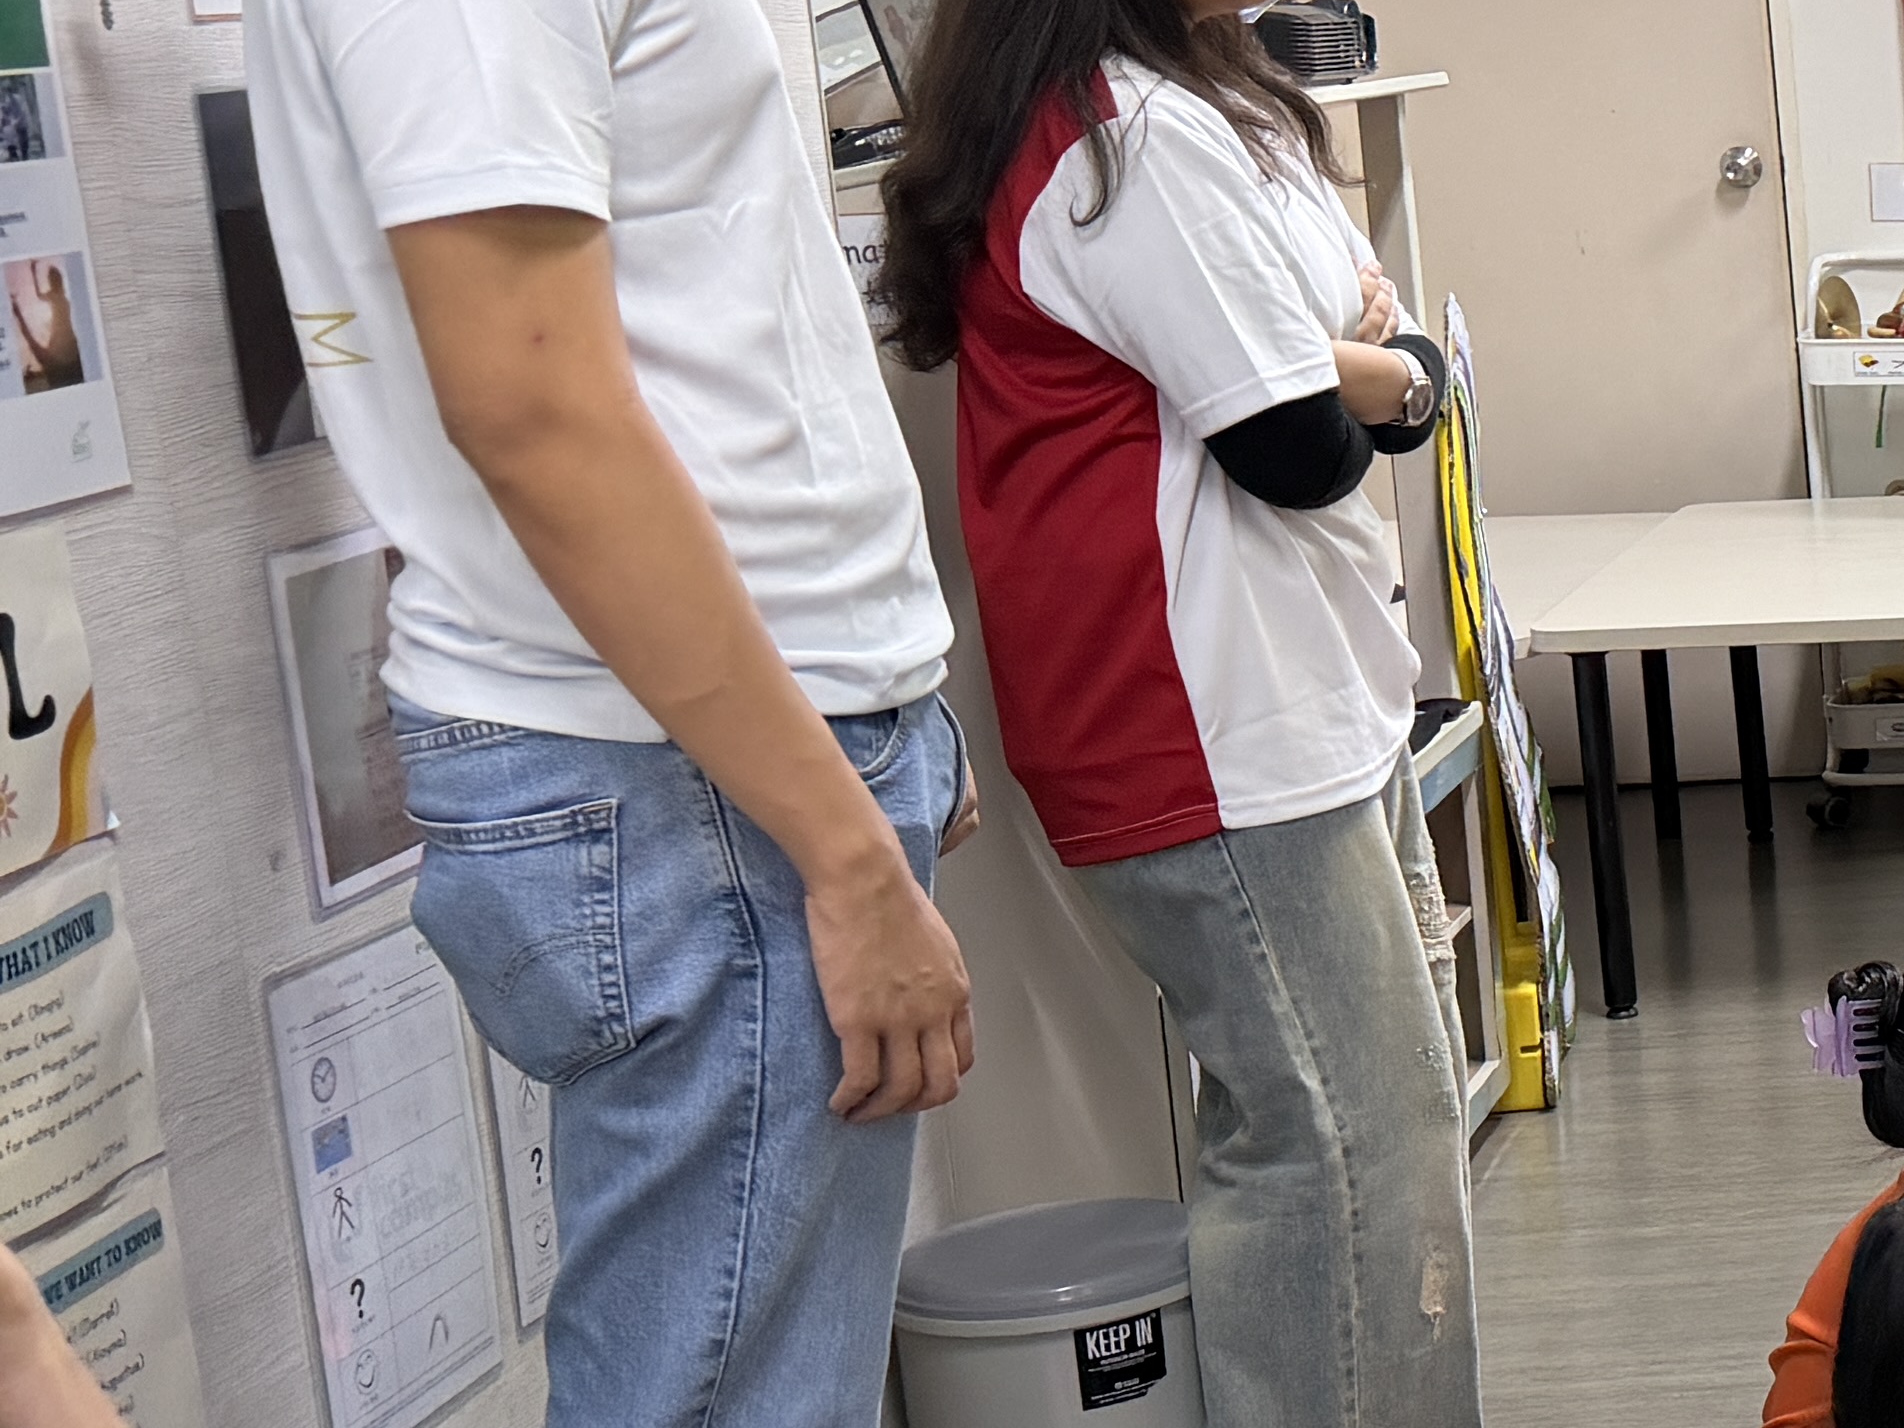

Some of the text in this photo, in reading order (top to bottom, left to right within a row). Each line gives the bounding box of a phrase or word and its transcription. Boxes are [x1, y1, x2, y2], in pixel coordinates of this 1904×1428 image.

[42, 936, 51, 962] I
[51, 909, 95, 957] KNOW
[64, 1256, 103, 1298] WANT
[104, 1244, 122, 1267] TO
[124, 1218, 163, 1257] KNOW
[1086, 1316, 1153, 1360] KEEP IN
